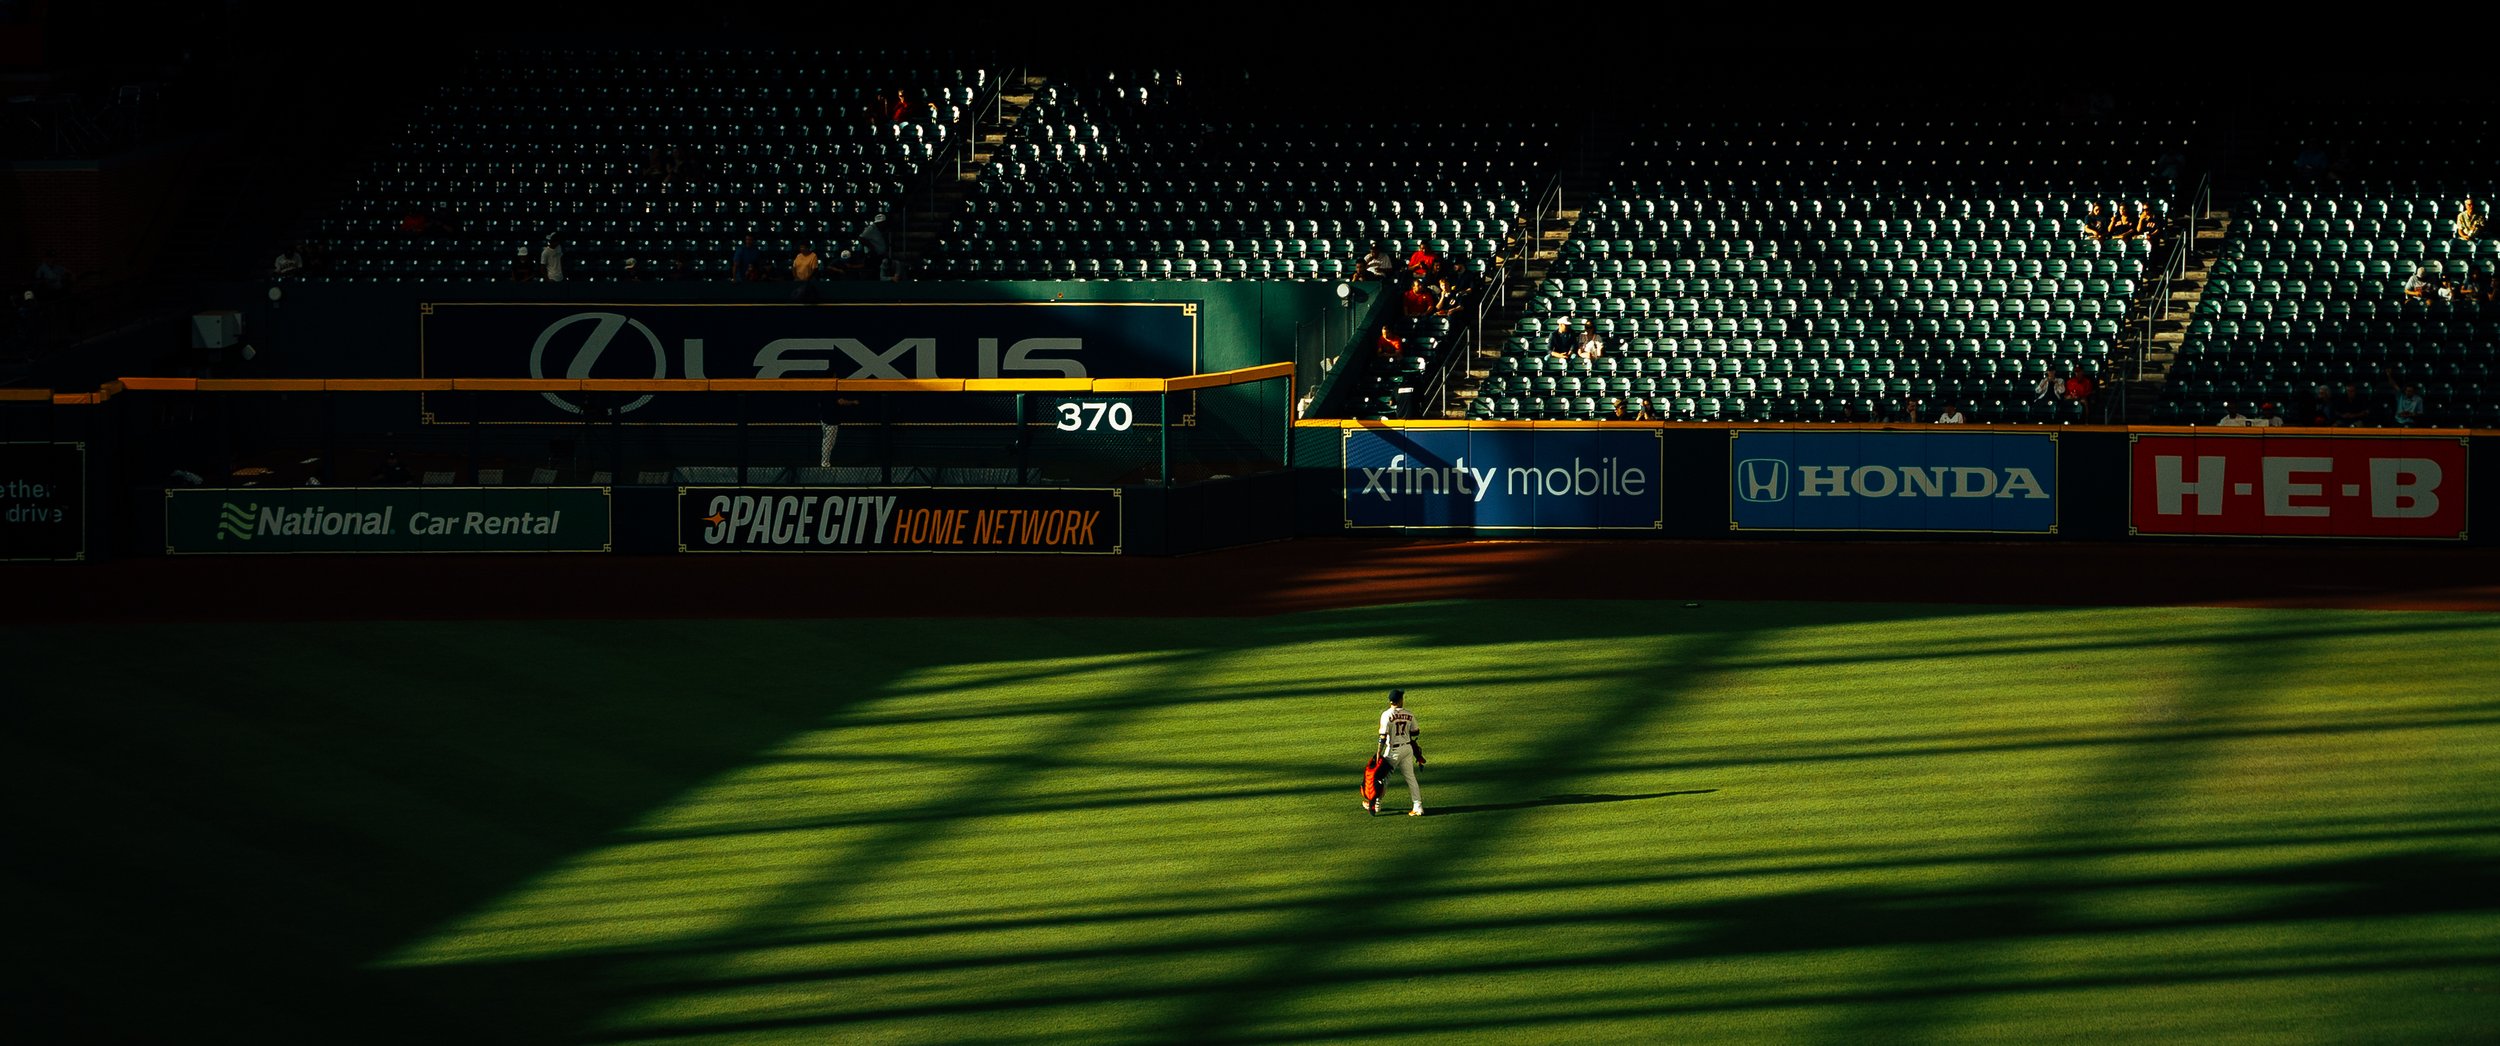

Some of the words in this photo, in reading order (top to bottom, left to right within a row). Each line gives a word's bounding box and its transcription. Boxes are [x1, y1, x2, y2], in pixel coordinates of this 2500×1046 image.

[682, 337, 1088, 379] LEXUS
[1057, 402, 1133, 431] 370
[1361, 454, 1497, 502] xfinity
[1507, 456, 1646, 496] mobile
[1799, 465, 2050, 499] HONDA
[6, 503, 63, 523] drive
[257, 505, 395, 536] National
[409, 511, 465, 536] Car
[463, 510, 561, 536] Rental
[704, 495, 818, 545] SPACE
[817, 495, 898, 545] CITY
[893, 508, 968, 545] HOME
[971, 508, 1101, 546] NETWORK
[1395, 721, 1407, 736] 17
